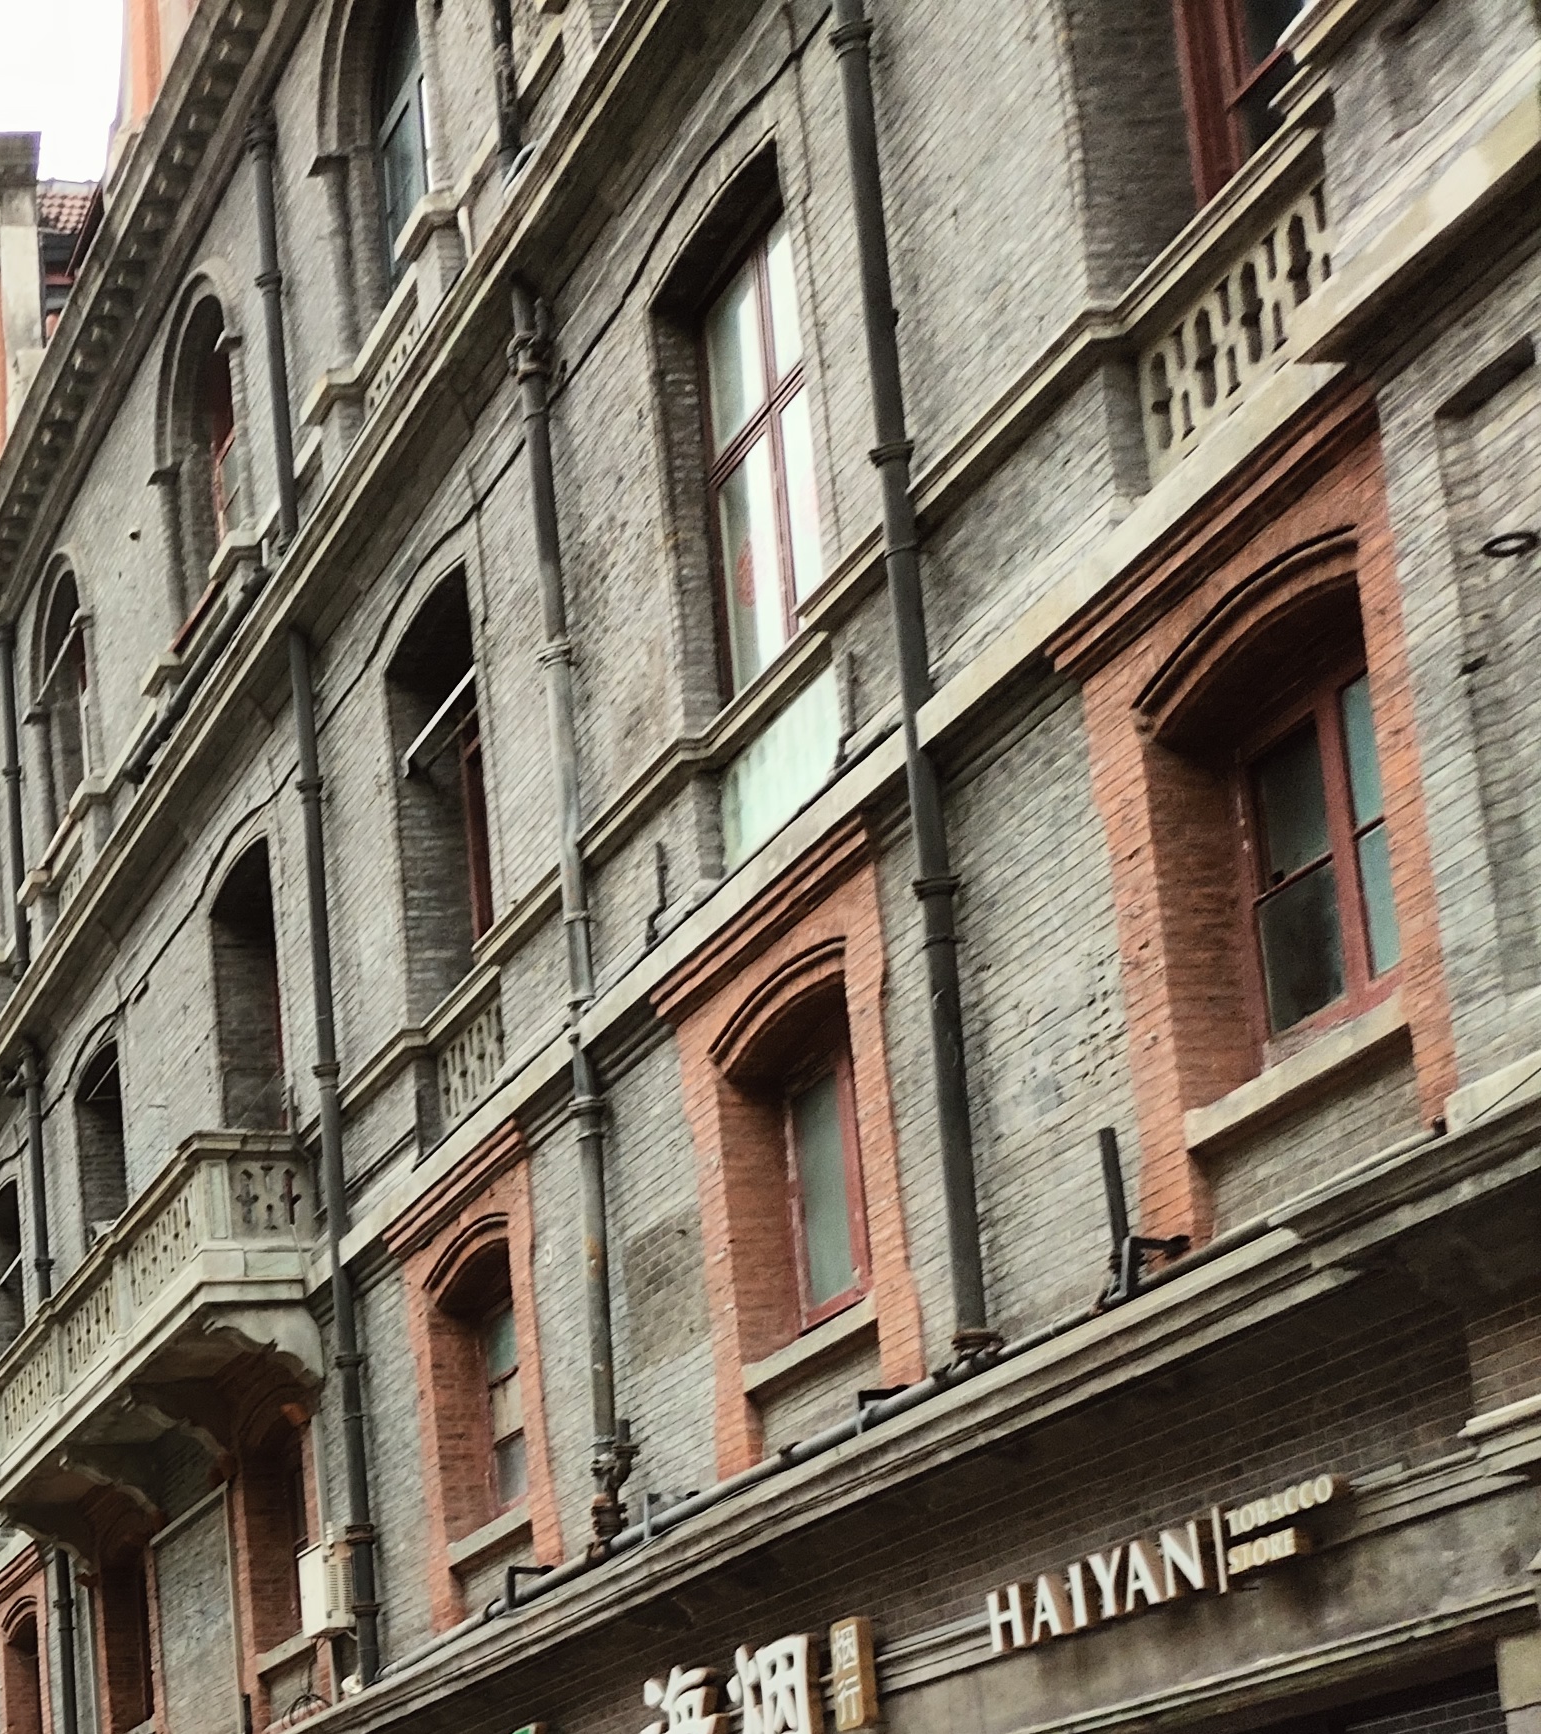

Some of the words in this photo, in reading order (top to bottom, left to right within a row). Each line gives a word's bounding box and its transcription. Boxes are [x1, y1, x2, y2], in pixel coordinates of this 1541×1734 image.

[1224, 1473, 1334, 1537] TOBACCO
[986, 1519, 1206, 1651] HAIYAN
[1226, 1526, 1298, 1575] STORE
[832, 1625, 862, 1725] 烟行
